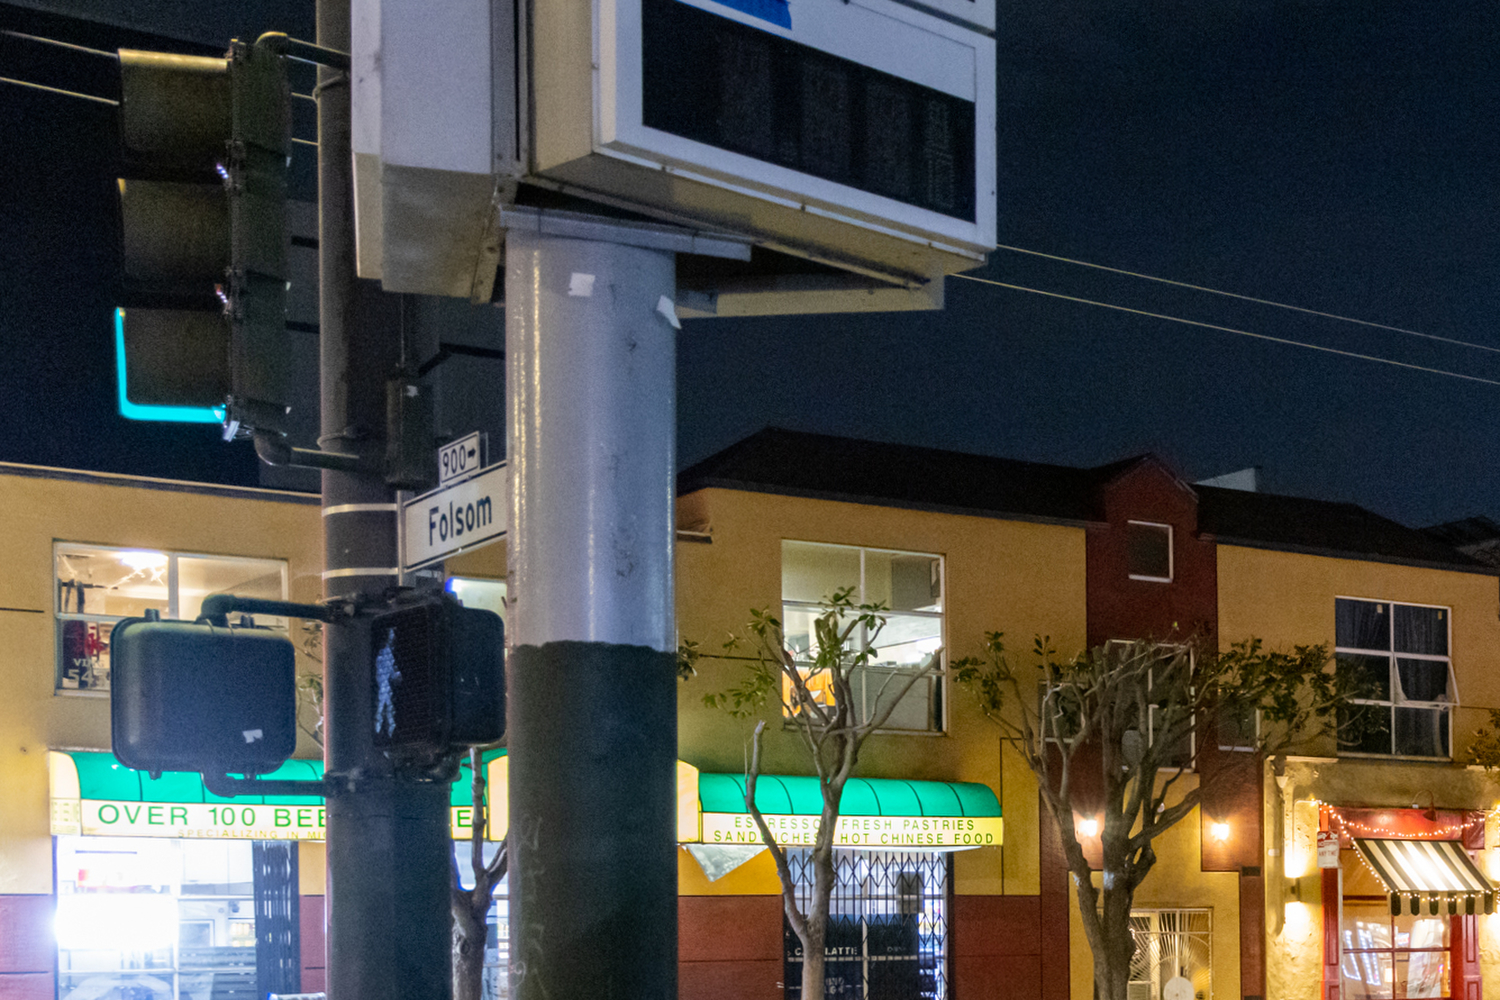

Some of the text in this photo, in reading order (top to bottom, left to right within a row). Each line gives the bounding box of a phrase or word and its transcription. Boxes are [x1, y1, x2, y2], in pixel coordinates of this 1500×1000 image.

[442, 445, 466, 477] 900
[429, 495, 492, 546] Folsom
[98, 804, 188, 826] OVER
[208, 806, 255, 827] 100
[735, 816, 974, 831] ESRESSO FRESH PASTRIES
[178, 829, 278, 839] SPECIALIZING
[286, 830, 299, 839] IN
[714, 830, 993, 844] SANDICHE HOT CHINESE FOOD
